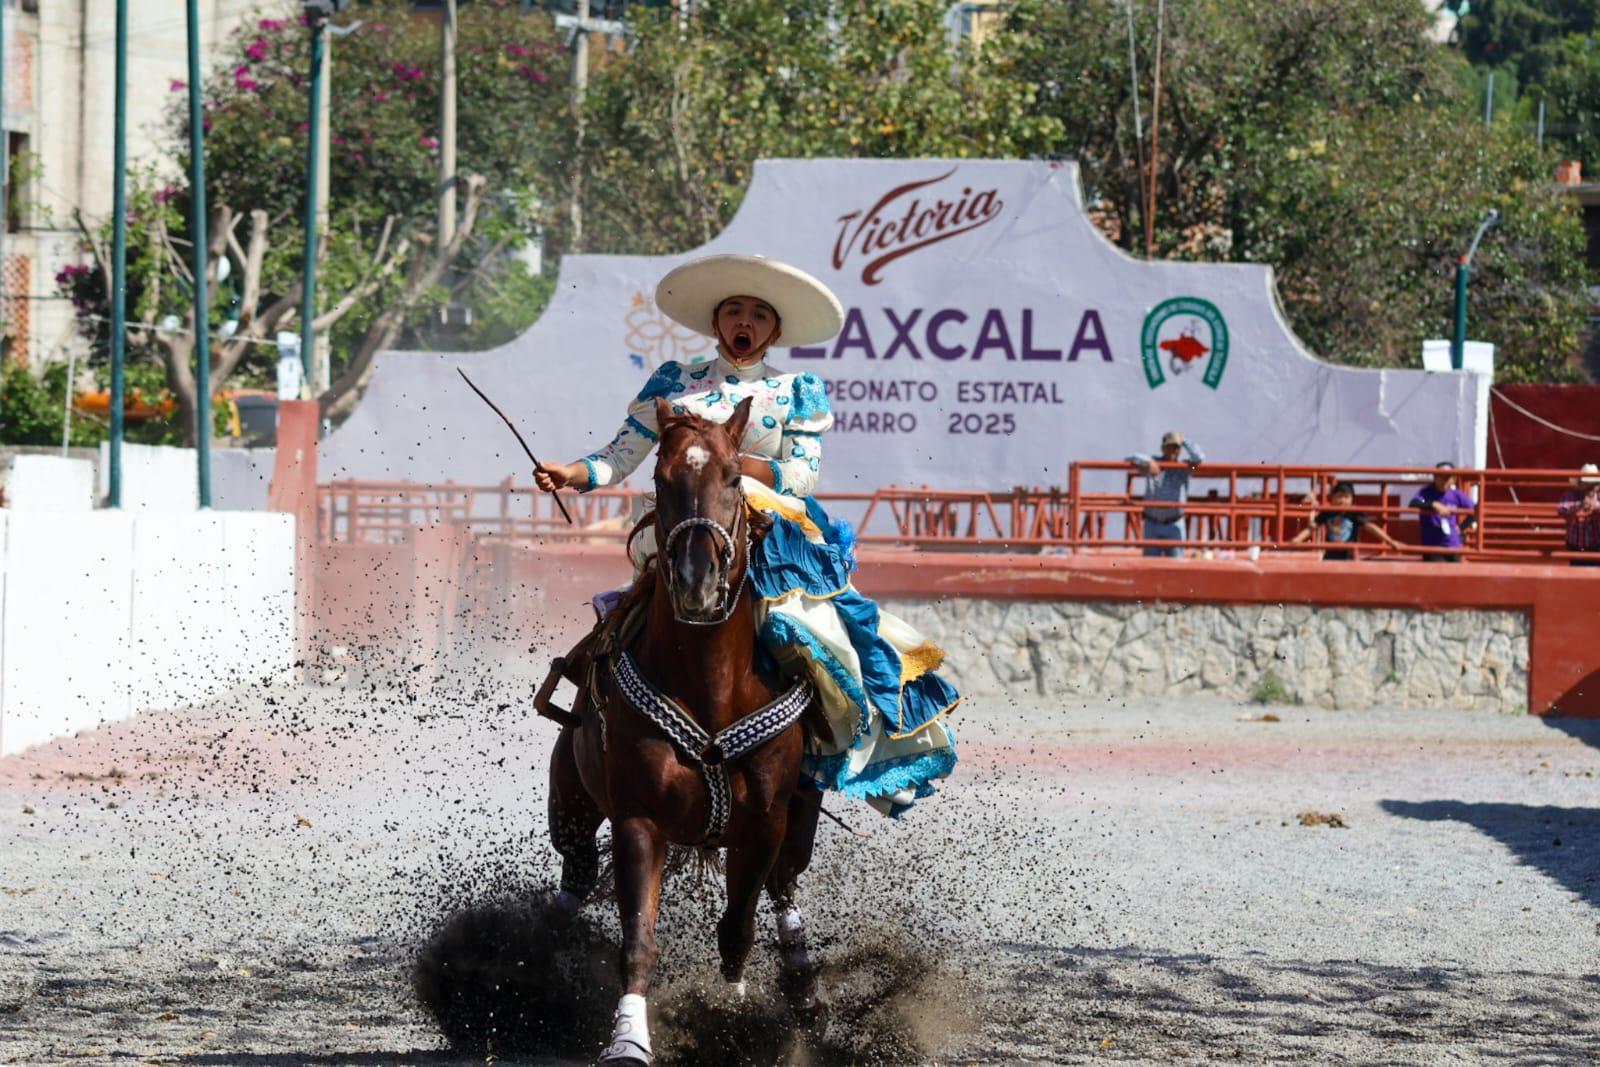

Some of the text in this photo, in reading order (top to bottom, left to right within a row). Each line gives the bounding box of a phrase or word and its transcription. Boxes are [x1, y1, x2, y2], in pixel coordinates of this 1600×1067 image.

[832, 165, 1004, 286] Victoria
[957, 381, 1064, 404] ESTATAL
[833, 412, 1017, 435] HARRO 2025
